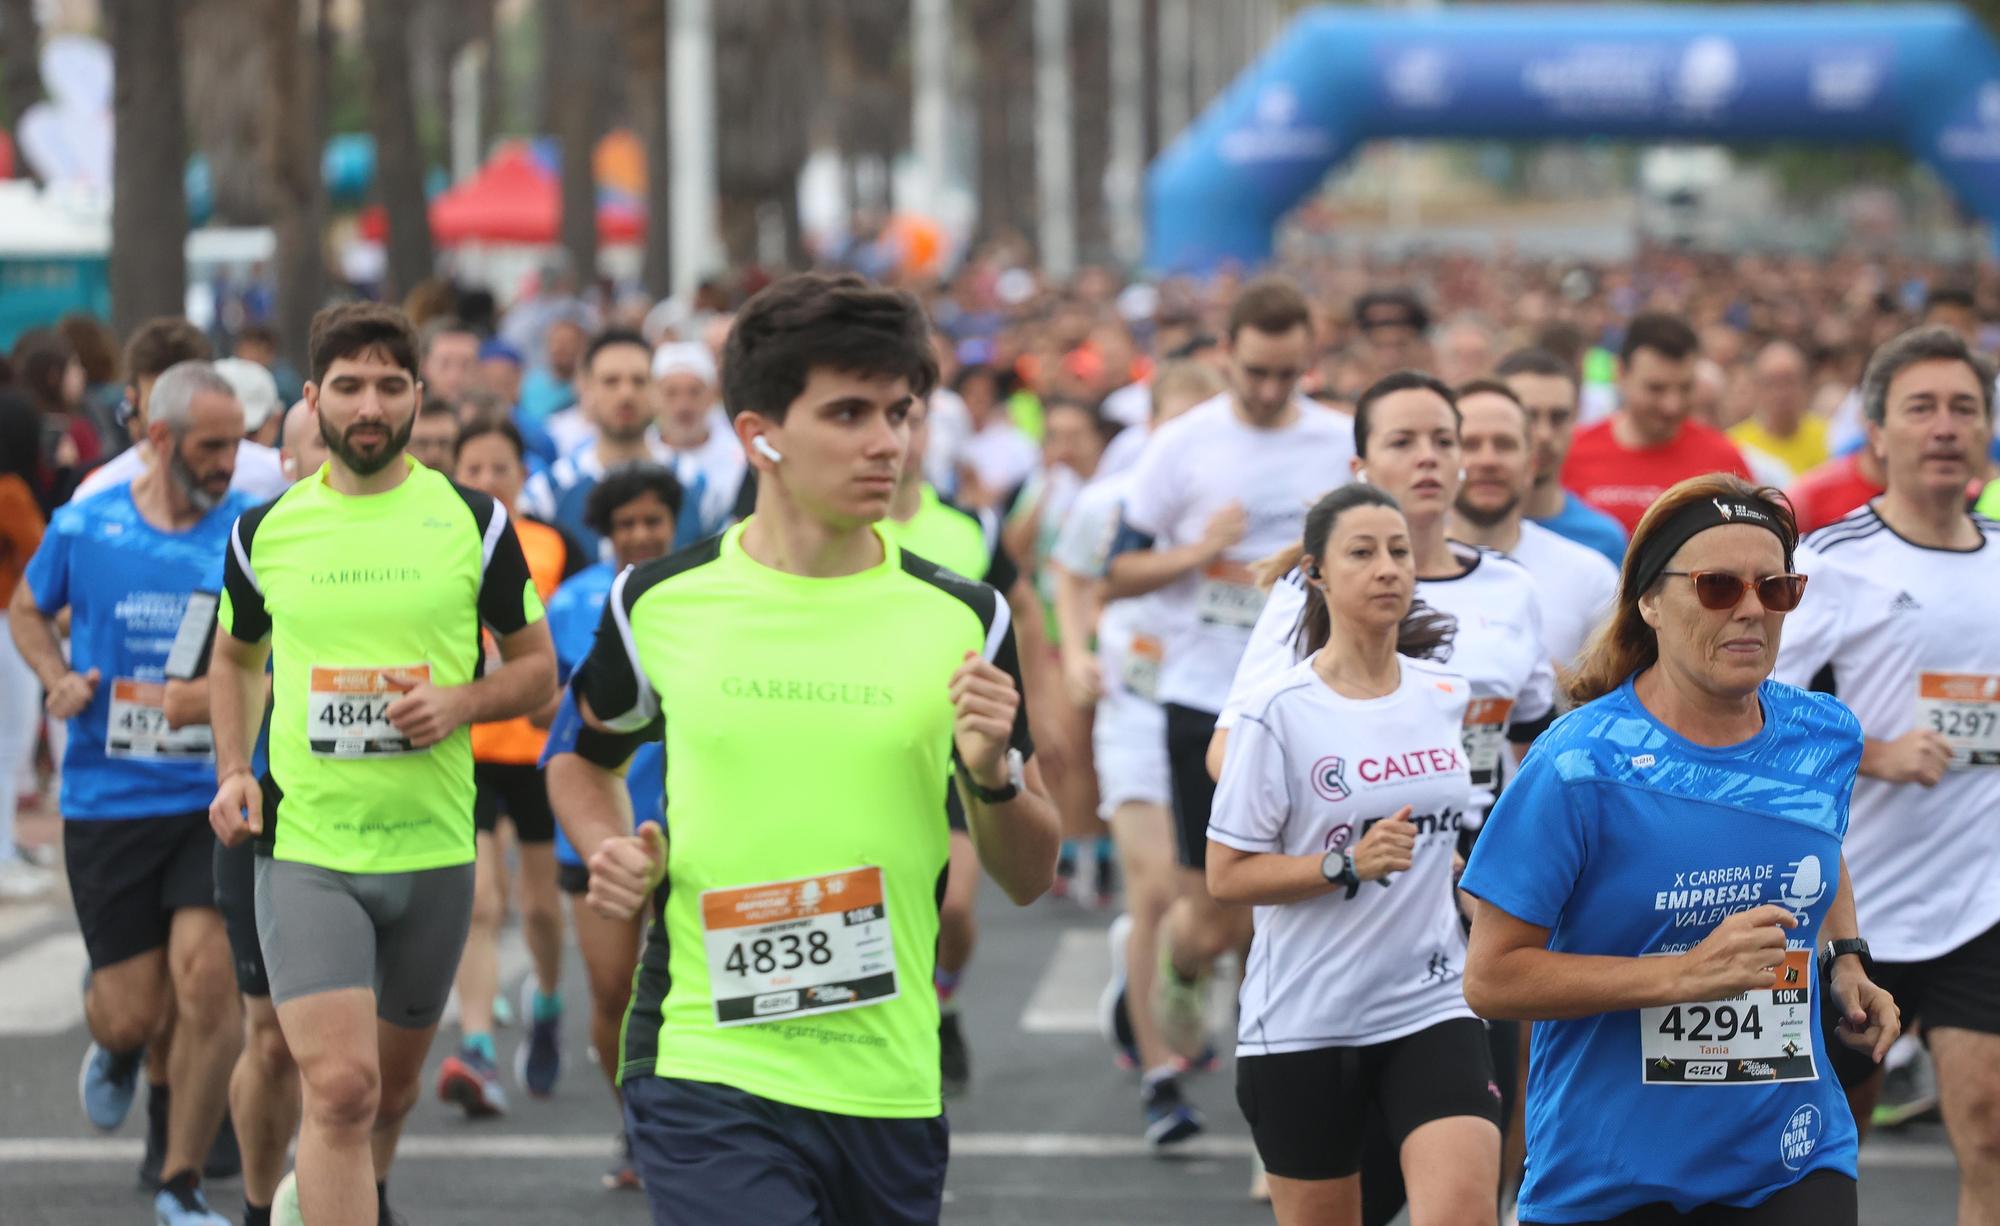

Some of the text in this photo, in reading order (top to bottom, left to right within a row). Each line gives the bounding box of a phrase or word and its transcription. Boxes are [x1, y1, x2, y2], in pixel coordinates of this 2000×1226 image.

[311, 568, 422, 585] GARRIGUES
[721, 676, 894, 706] GARRIGUES
[1929, 708, 1997, 738] 3297
[1358, 748, 1464, 783] CALTEX
[1674, 864, 1774, 888] X CARRERA DE
[1654, 883, 1762, 911] EMPRESAS
[724, 930, 832, 978] 4838
[1776, 989, 1799, 1004] 10K
[1658, 1005, 1763, 1041] 4294
[1699, 1044, 1729, 1055] Tania
[1688, 1064, 1723, 1076] 42K
[1791, 1110, 1812, 1130] #BE
[1784, 1126, 1807, 1148] RUN
